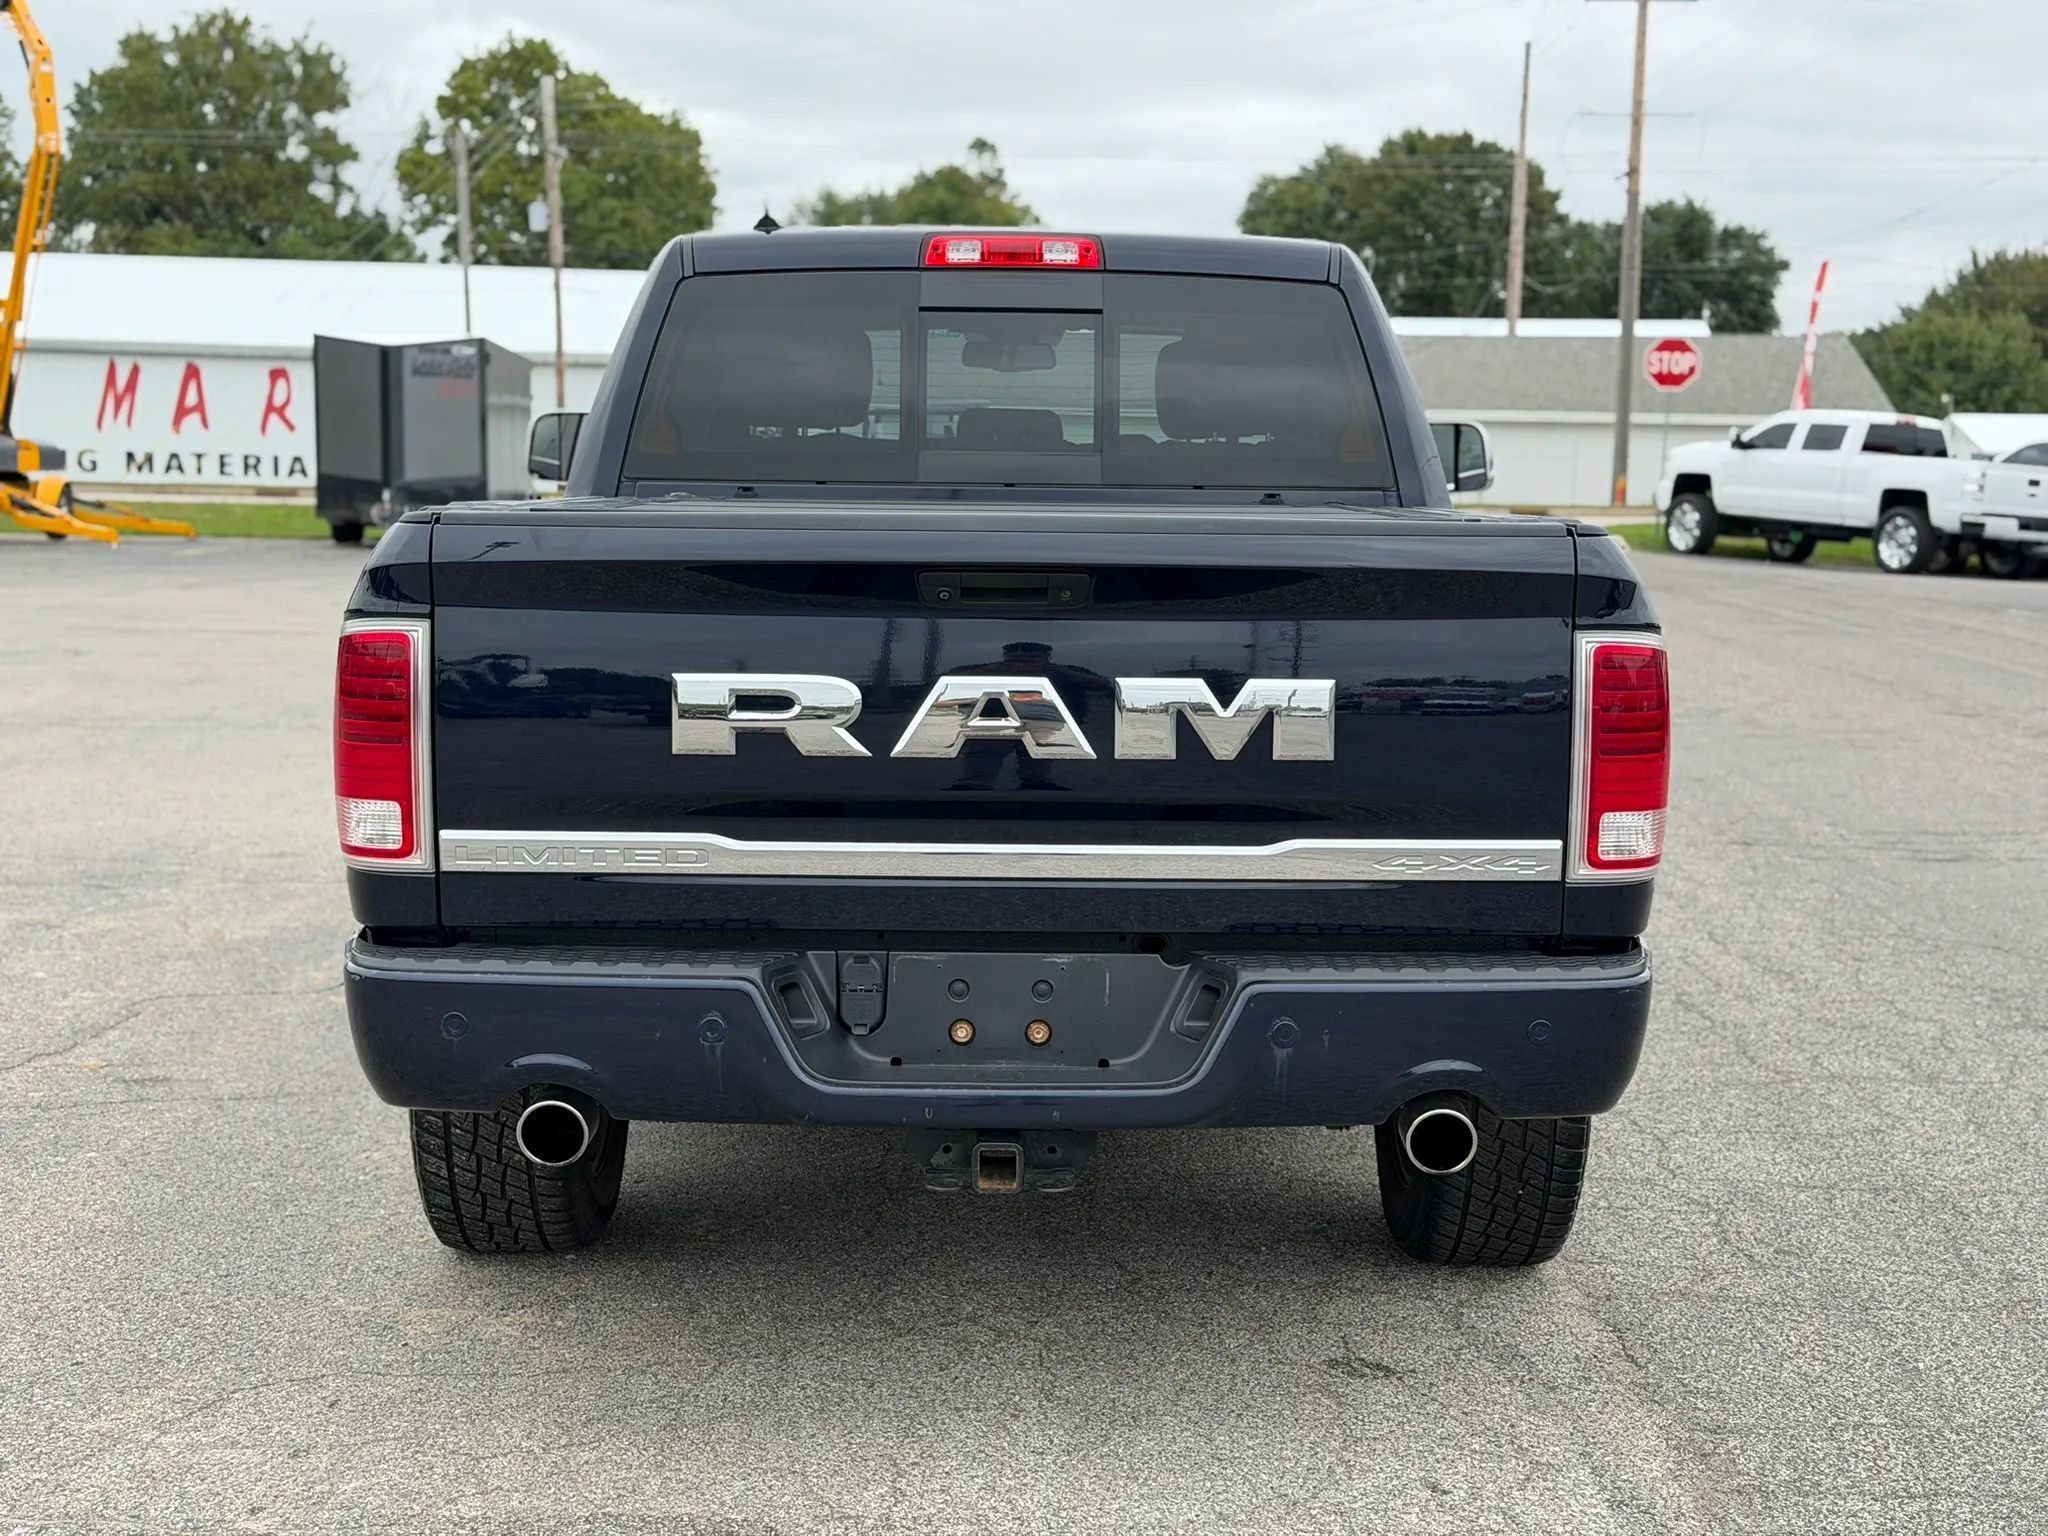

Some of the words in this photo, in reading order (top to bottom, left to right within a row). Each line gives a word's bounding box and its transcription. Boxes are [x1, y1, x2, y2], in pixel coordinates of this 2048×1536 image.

[1648, 350, 1697, 375] STOP
[125, 451, 309, 478] MATERIA
[671, 672, 1337, 761] RAM
[454, 845, 710, 867] LIMITED
[1371, 854, 1552, 874] 4X4
